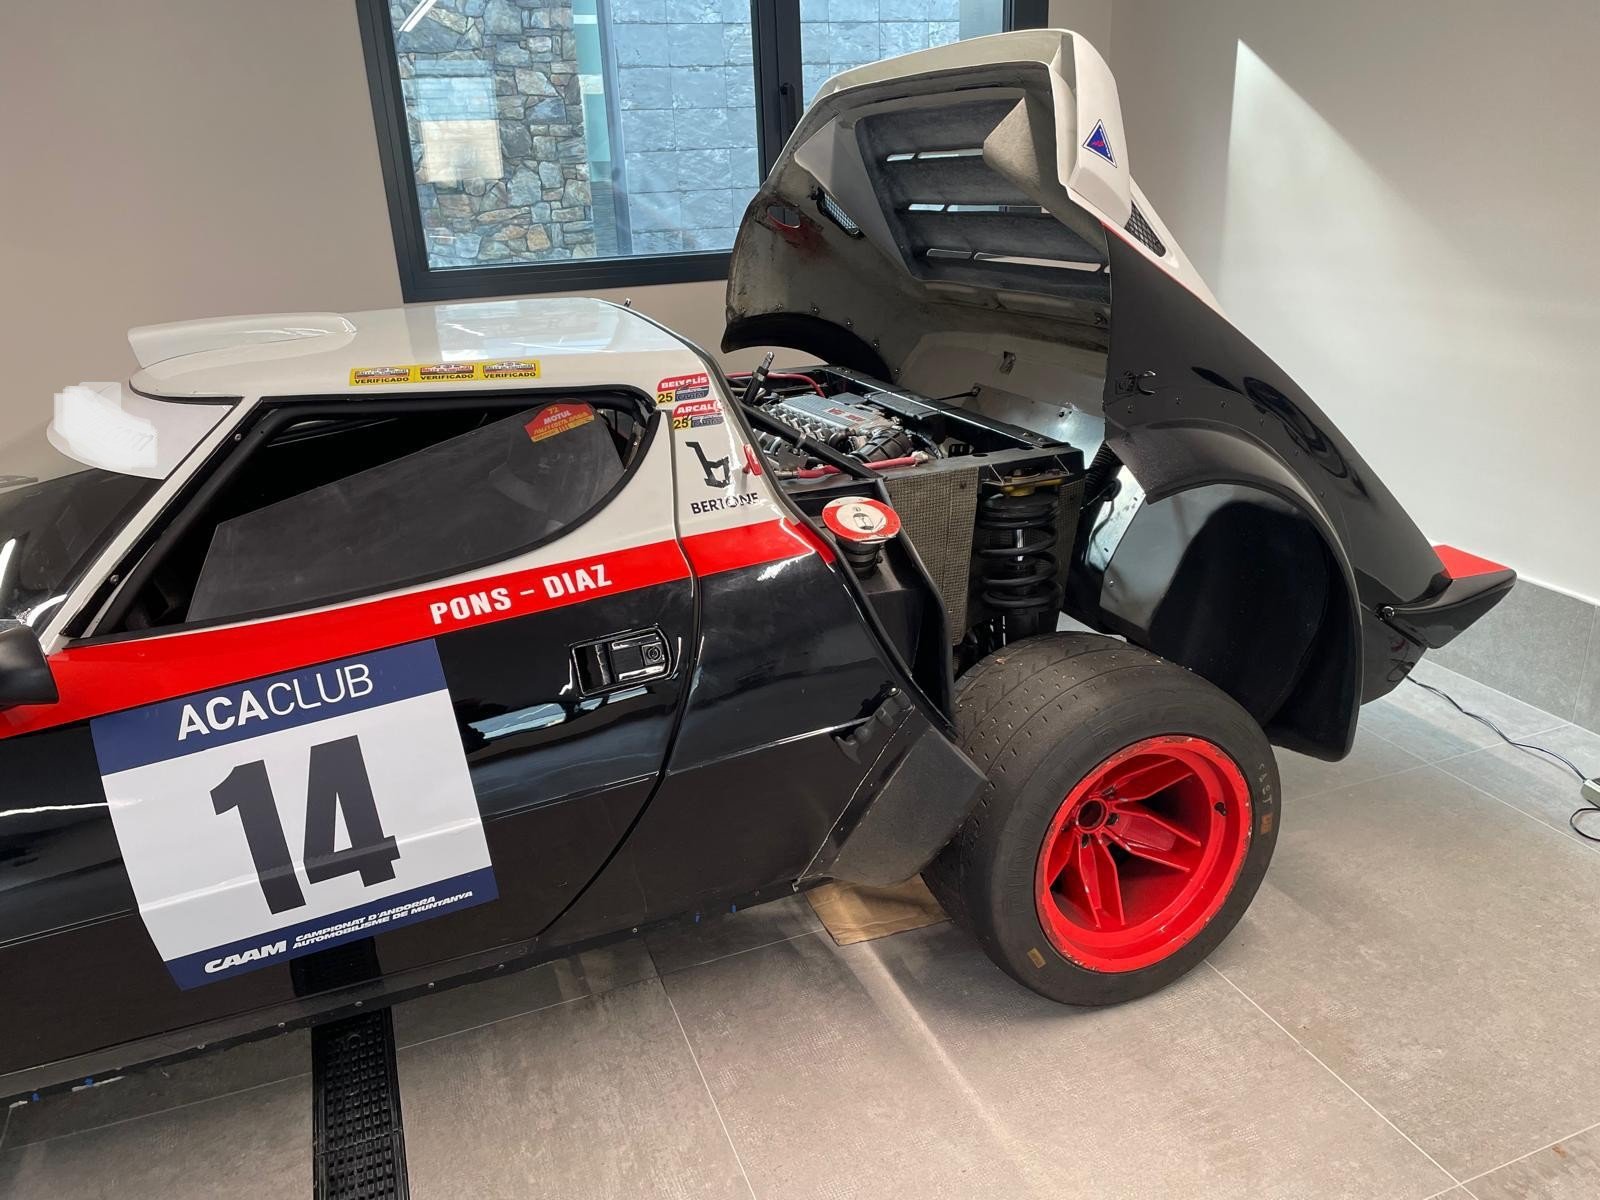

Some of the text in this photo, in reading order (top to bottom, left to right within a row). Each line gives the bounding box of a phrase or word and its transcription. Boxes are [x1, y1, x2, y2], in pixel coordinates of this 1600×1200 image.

[354, 376, 409, 384] VERIFICADO
[420, 373, 474, 381] VERIFICADO
[484, 371, 537, 379] VERIFICADO
[657, 392, 673, 403] 25
[543, 409, 573, 425] MOTUL
[674, 419, 688, 429] 25
[429, 587, 512, 625] PONS
[542, 564, 612, 599] DIAZ
[177, 662, 374, 742] ACACLUB
[209, 734, 401, 916] 14
[292, 890, 474, 949] AUTOMOBILISME DE MUNTANYA
[295, 896, 436, 943] CAMPIONAT D'ANDORRA
[204, 940, 288, 974] CAAM
